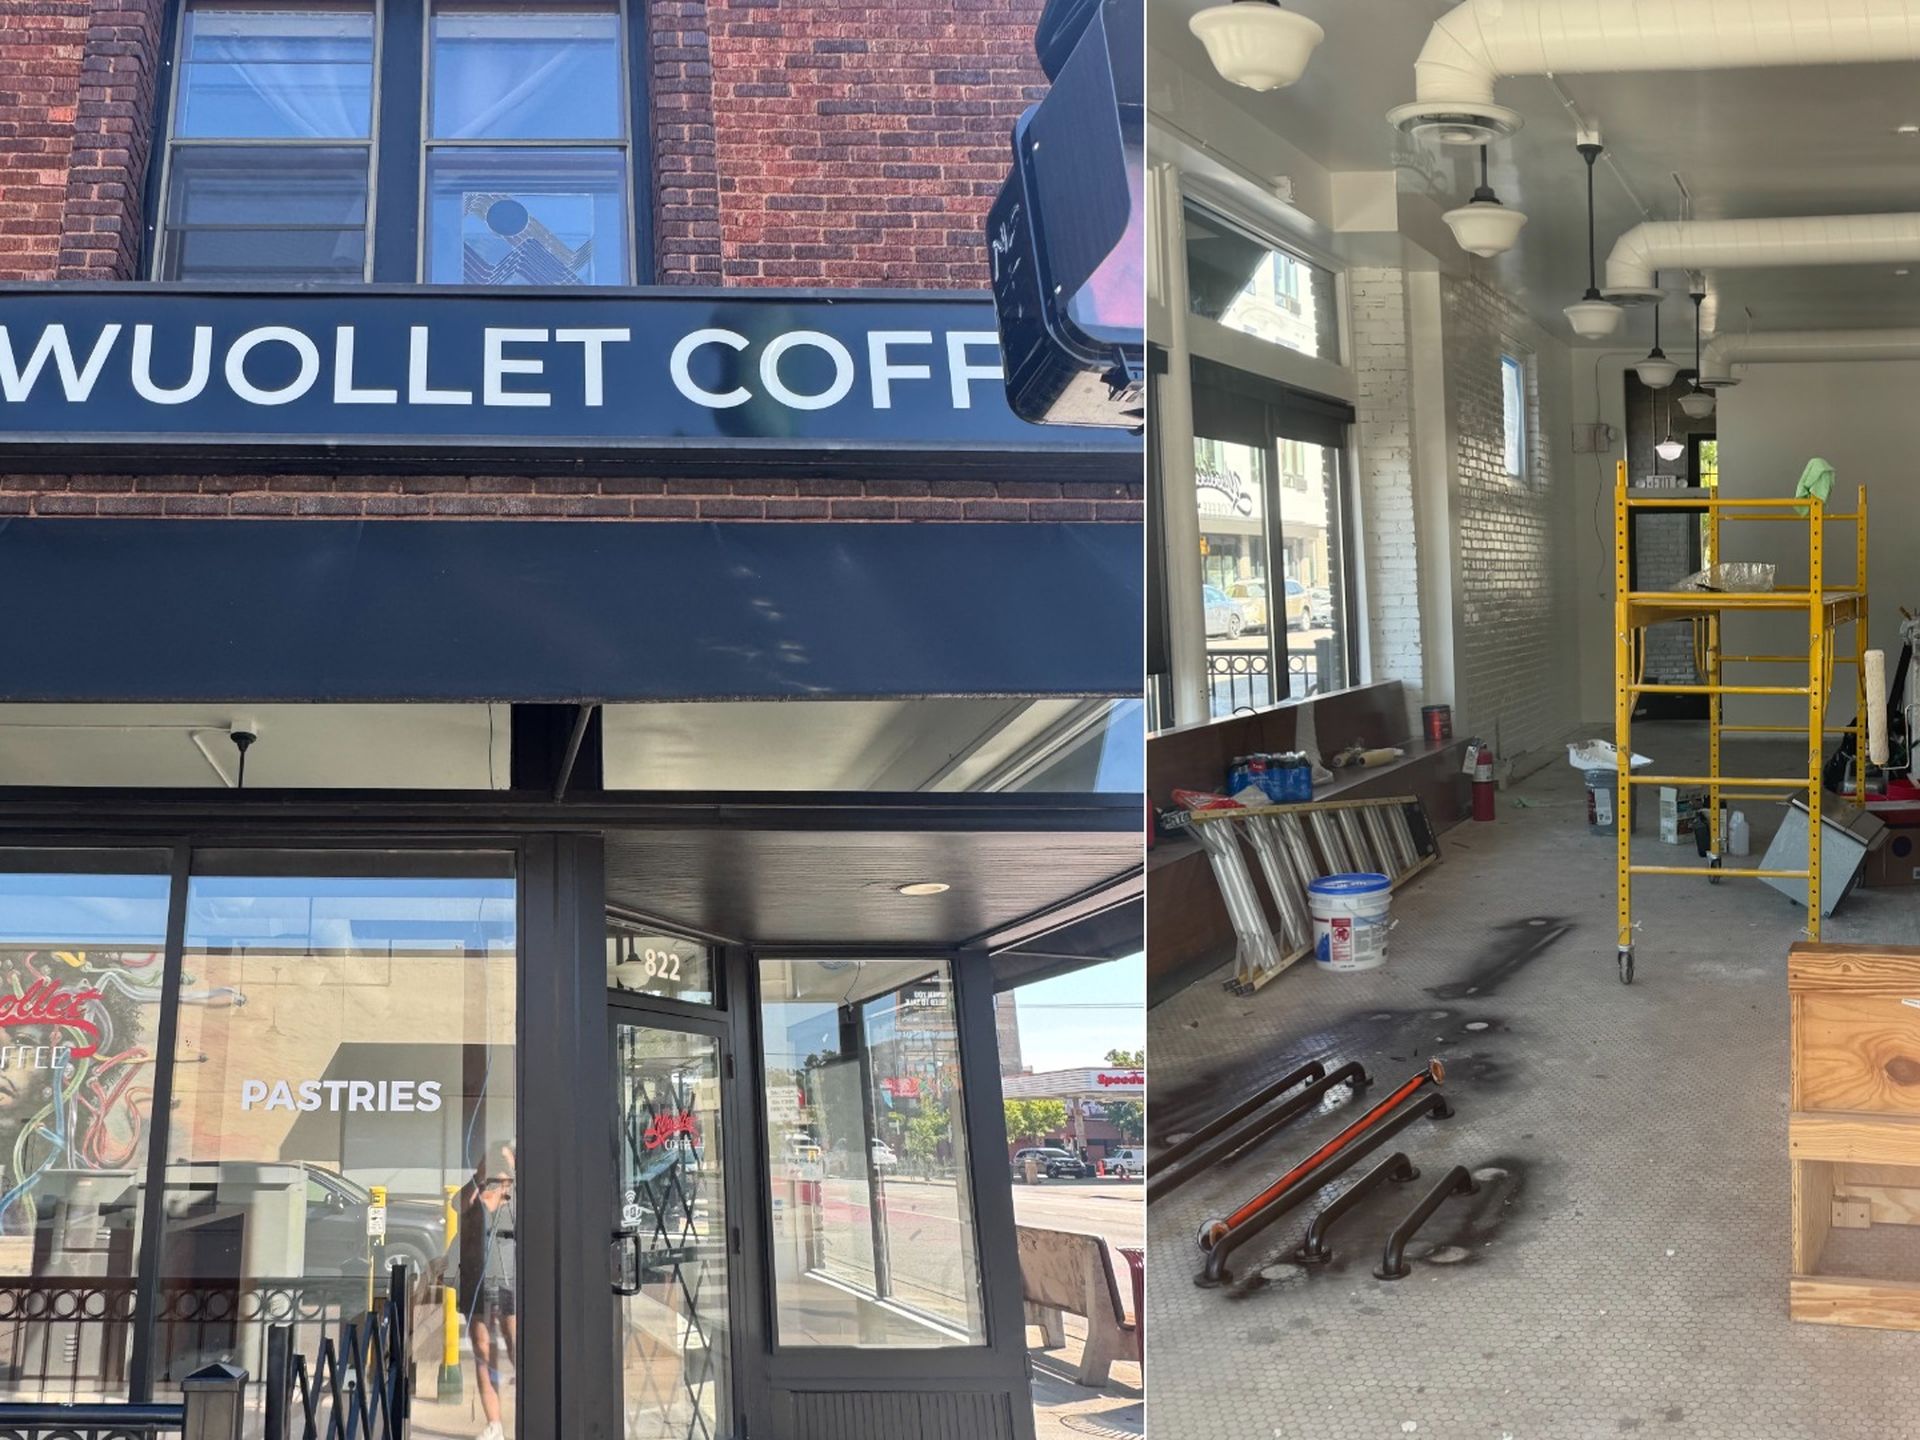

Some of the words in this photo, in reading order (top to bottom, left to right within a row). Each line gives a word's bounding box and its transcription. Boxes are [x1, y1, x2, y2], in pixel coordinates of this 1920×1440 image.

[0, 323, 630, 406] WUOLLET
[645, 948, 681, 981] 822
[241, 1080, 442, 1112] PASTRIES
